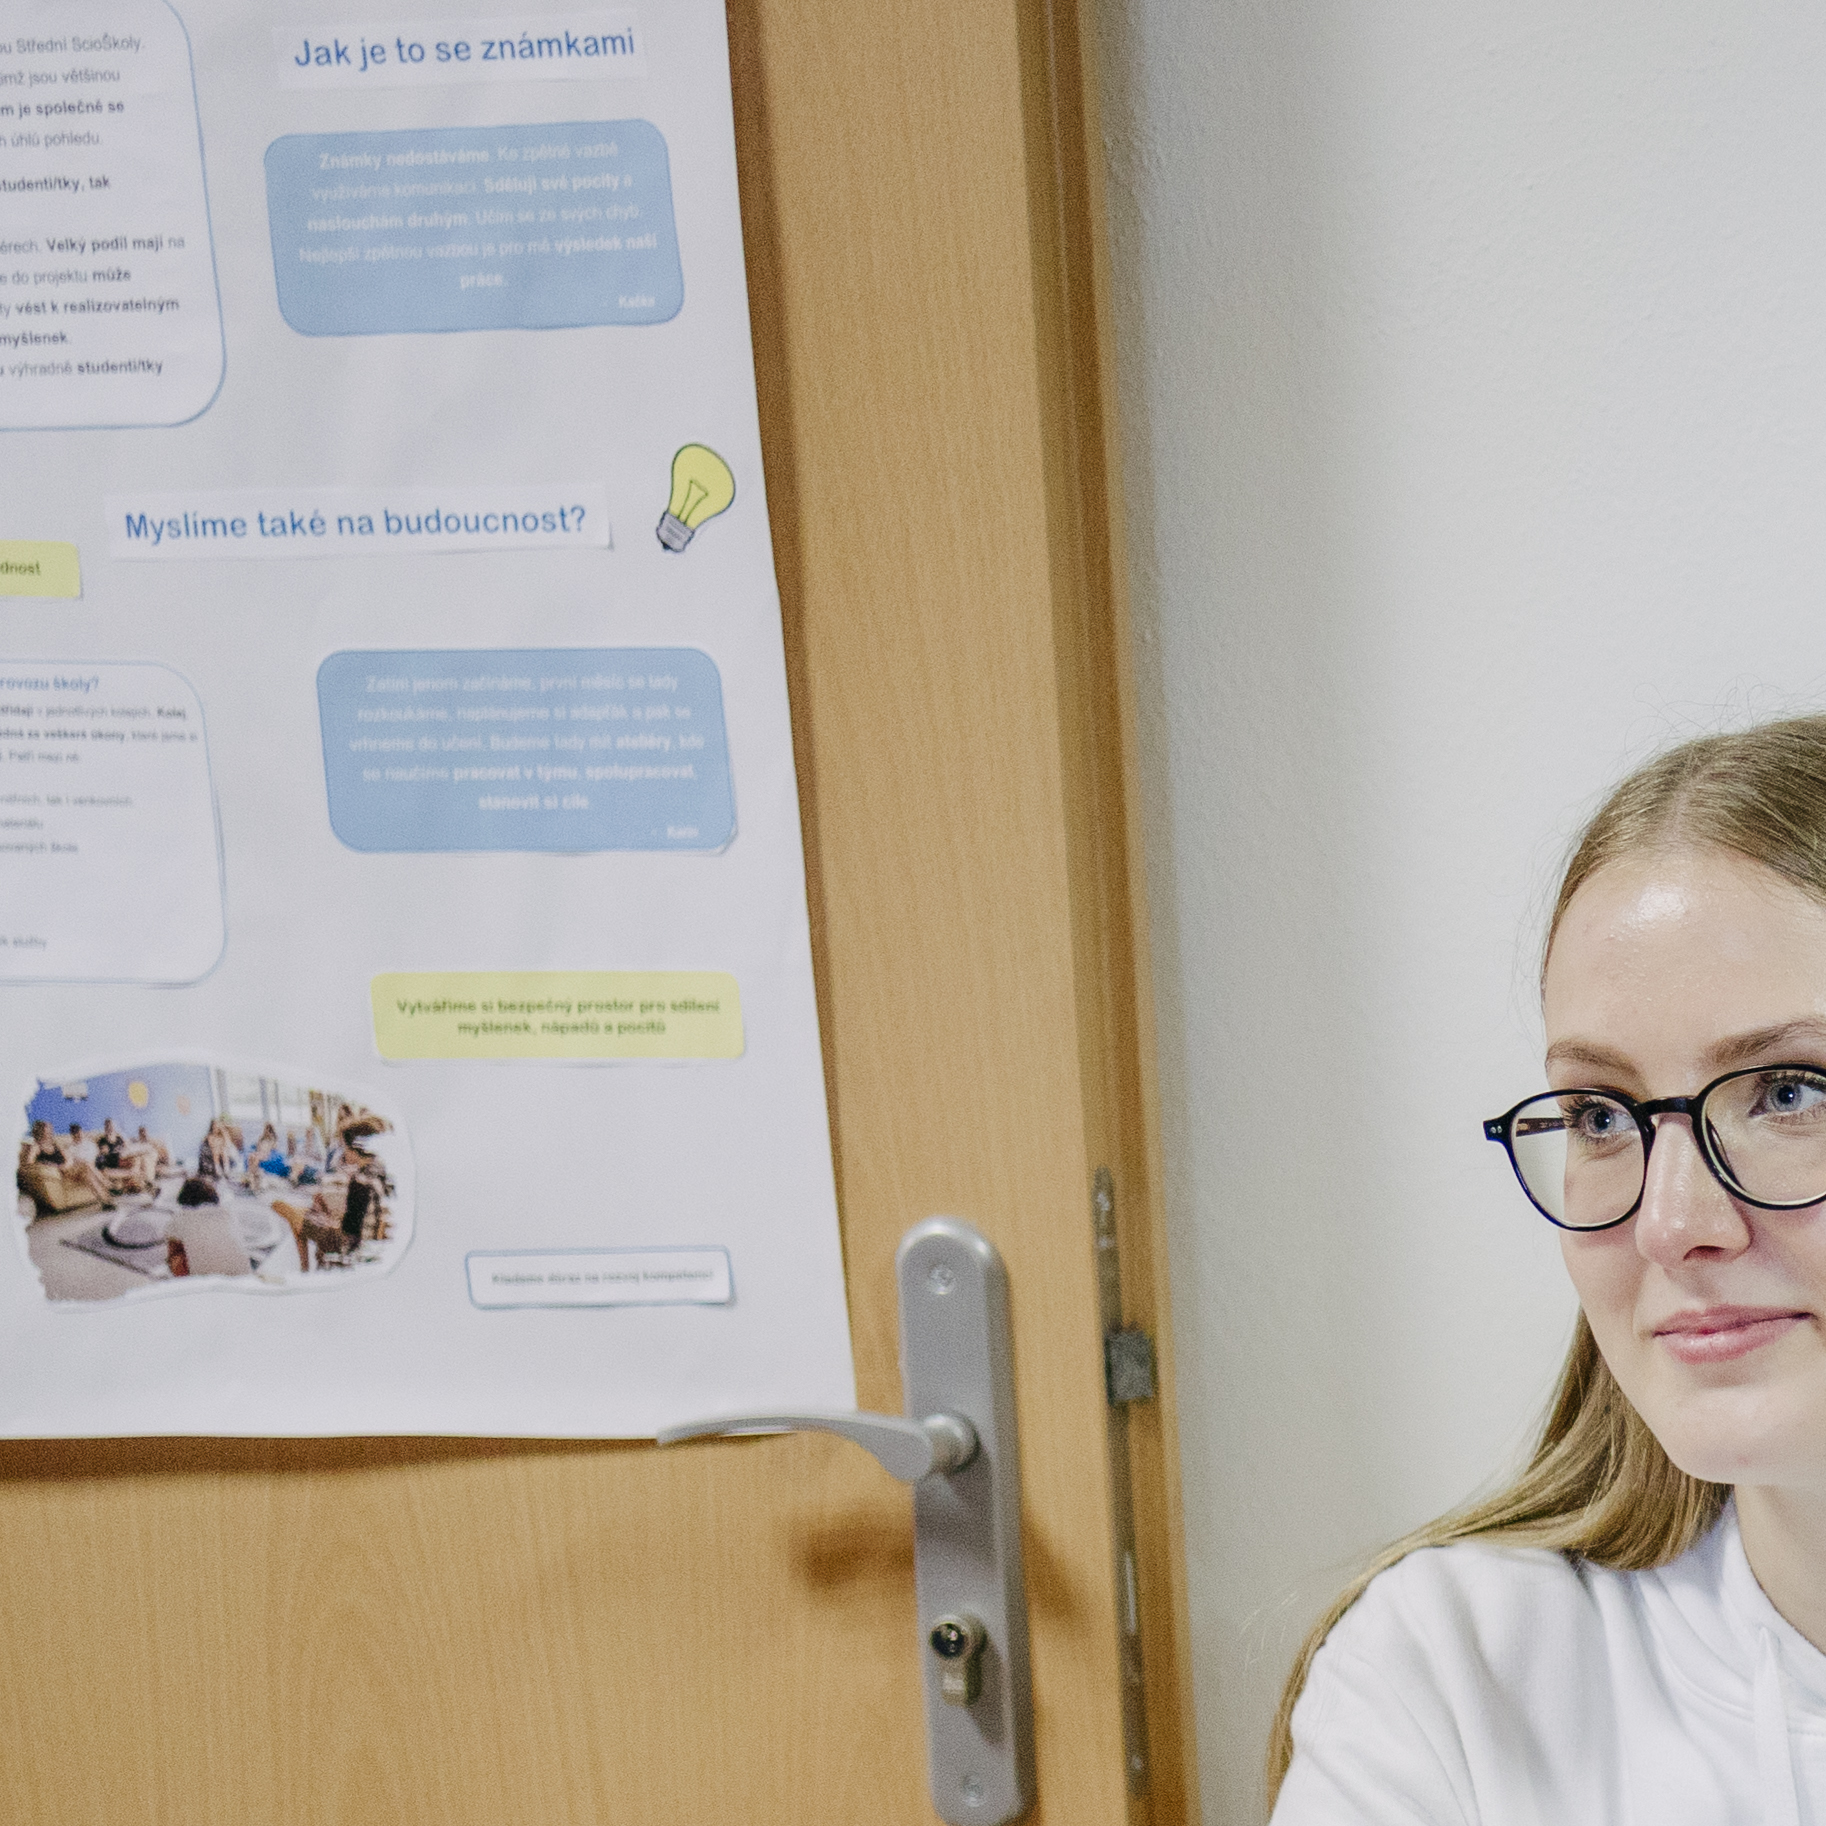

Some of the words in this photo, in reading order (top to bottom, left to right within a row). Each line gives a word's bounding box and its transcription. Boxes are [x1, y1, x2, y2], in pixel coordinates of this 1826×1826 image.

[295, 38, 351, 67] Jak
[359, 38, 387, 73] je
[396, 38, 425, 63] to
[436, 40, 471, 63] se
[481, 27, 634, 60] známkami
[108, 100, 125, 113] se
[0, 175, 85, 195] tudenti/tky,
[89, 174, 111, 190] tak
[46, 236, 87, 254] Velký
[168, 237, 186, 249] na
[11, 269, 30, 285] do
[125, 510, 248, 547] Myslíme
[259, 509, 327, 537] také
[336, 513, 375, 536] na
[383, 505, 586, 535] budoucnost?
